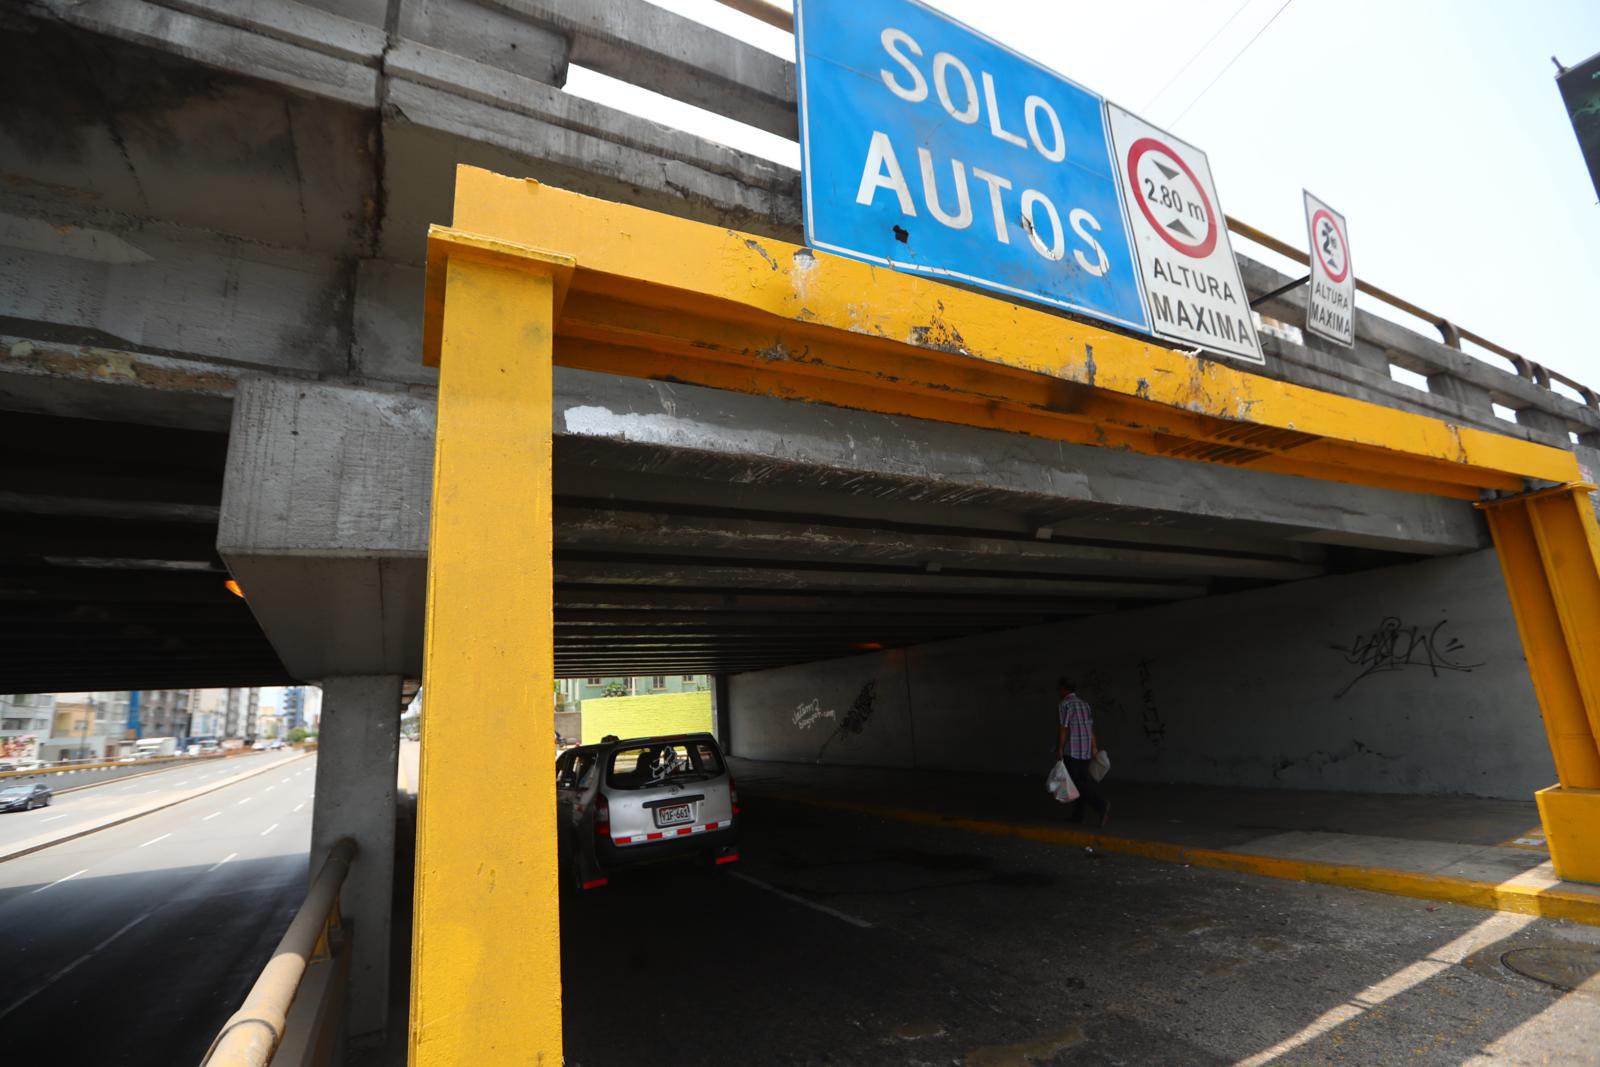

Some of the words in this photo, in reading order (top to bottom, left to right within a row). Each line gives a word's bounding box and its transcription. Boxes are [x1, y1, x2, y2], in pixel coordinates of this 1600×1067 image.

[880, 27, 1066, 163] SOLO
[856, 130, 1111, 278] AUTOS
[1144, 177, 1183, 215] 2.80
[1186, 202, 1206, 224] m
[1153, 257, 1234, 304] ALTURA
[1315, 282, 1348, 310] ALTURA
[1155, 291, 1252, 349] MAXIMA
[1311, 301, 1351, 337] MAXIMA
